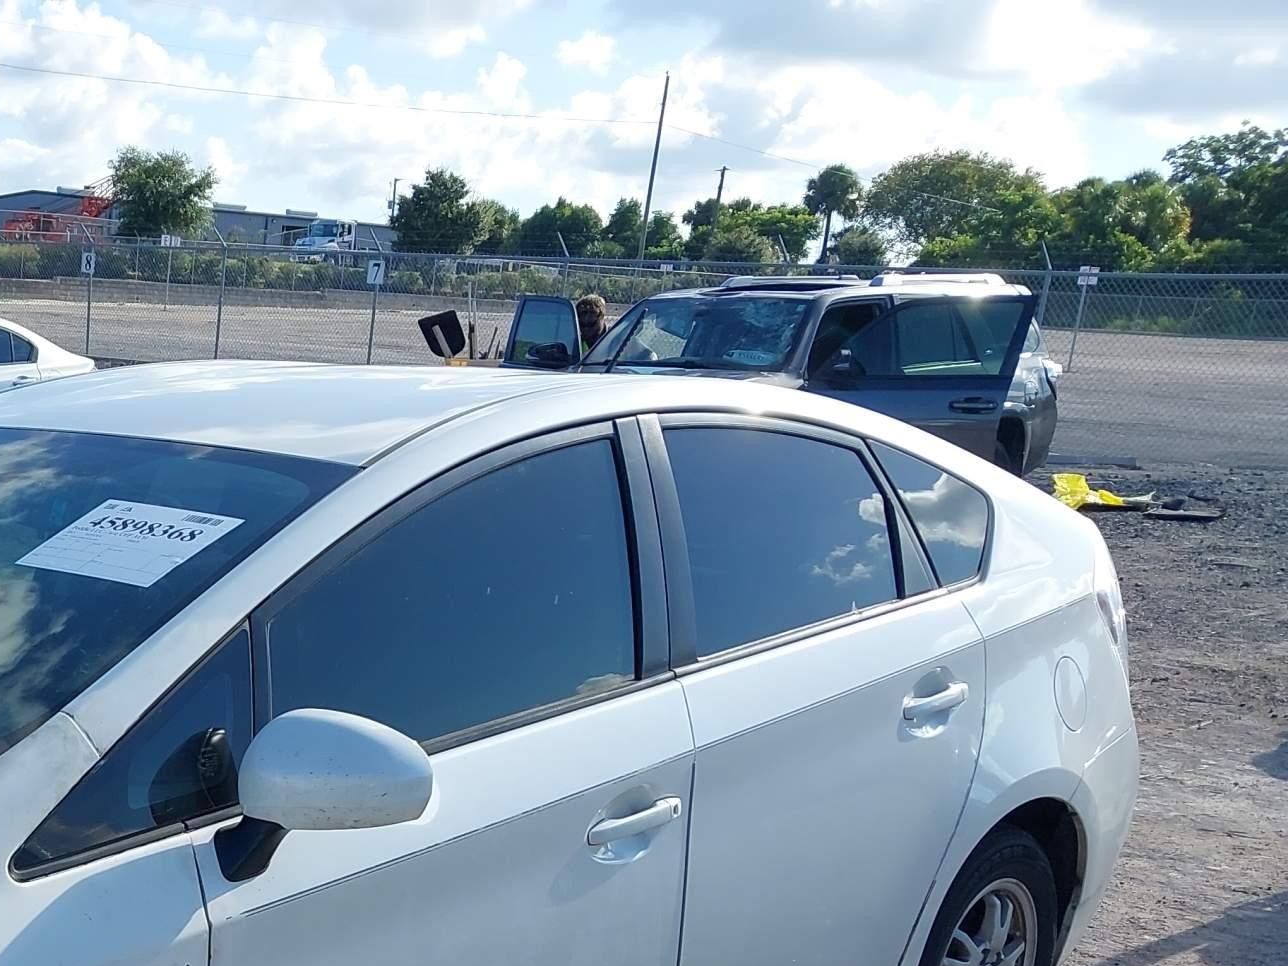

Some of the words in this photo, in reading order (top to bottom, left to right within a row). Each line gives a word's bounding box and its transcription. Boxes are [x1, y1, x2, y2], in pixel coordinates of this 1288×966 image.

[85, 254, 92, 270] 8
[372, 262, 381, 282] 7
[89, 515, 205, 542] 45898368
